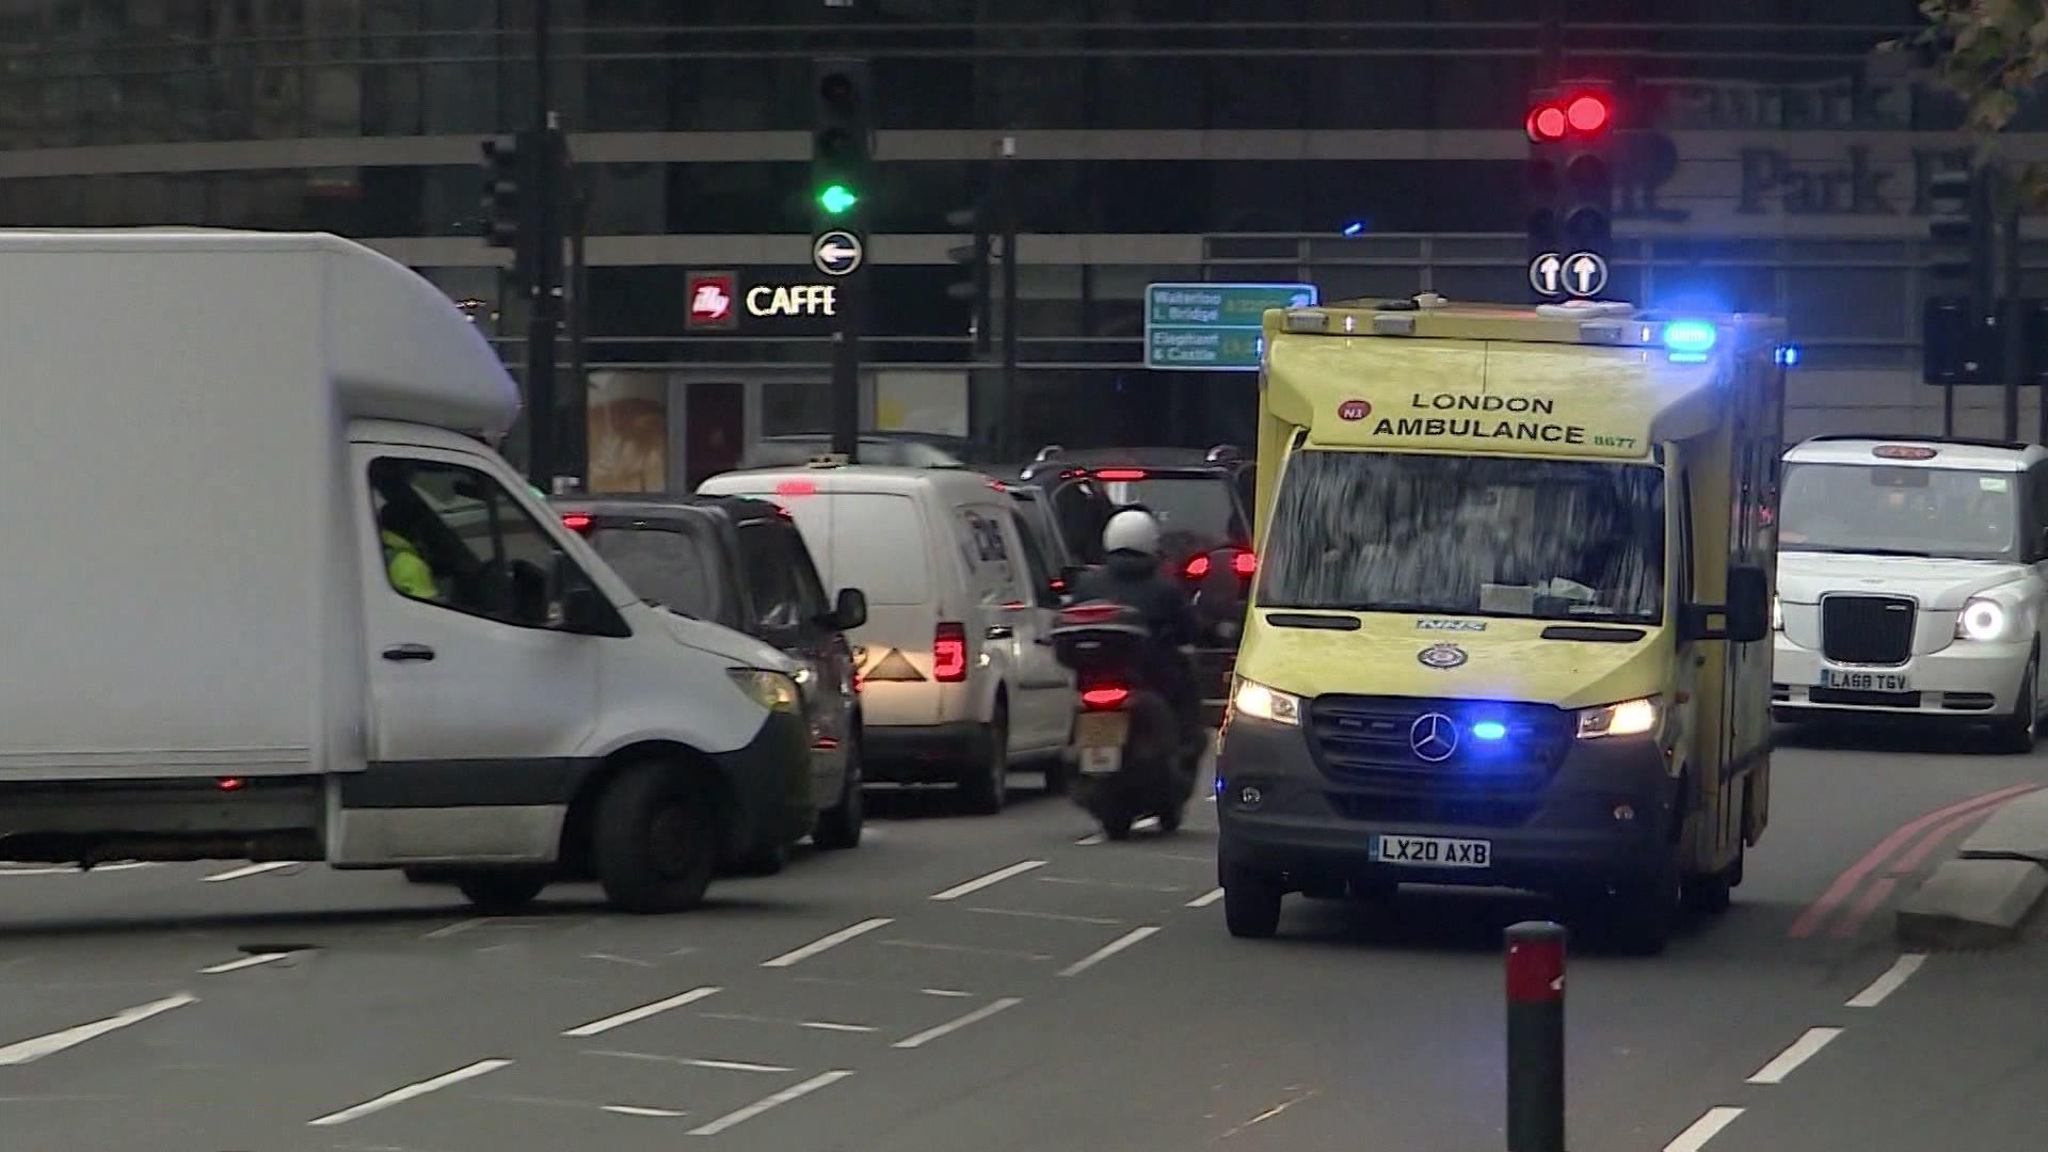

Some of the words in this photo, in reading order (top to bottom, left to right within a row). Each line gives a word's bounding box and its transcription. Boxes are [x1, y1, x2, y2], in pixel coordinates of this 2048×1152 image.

[1738, 144, 1892, 215] Park
[1411, 393, 1554, 415] LONDON
[1373, 418, 1586, 445] AMBULANCE
[1382, 839, 1439, 861] LX20
[1445, 842, 1487, 864] AXB
